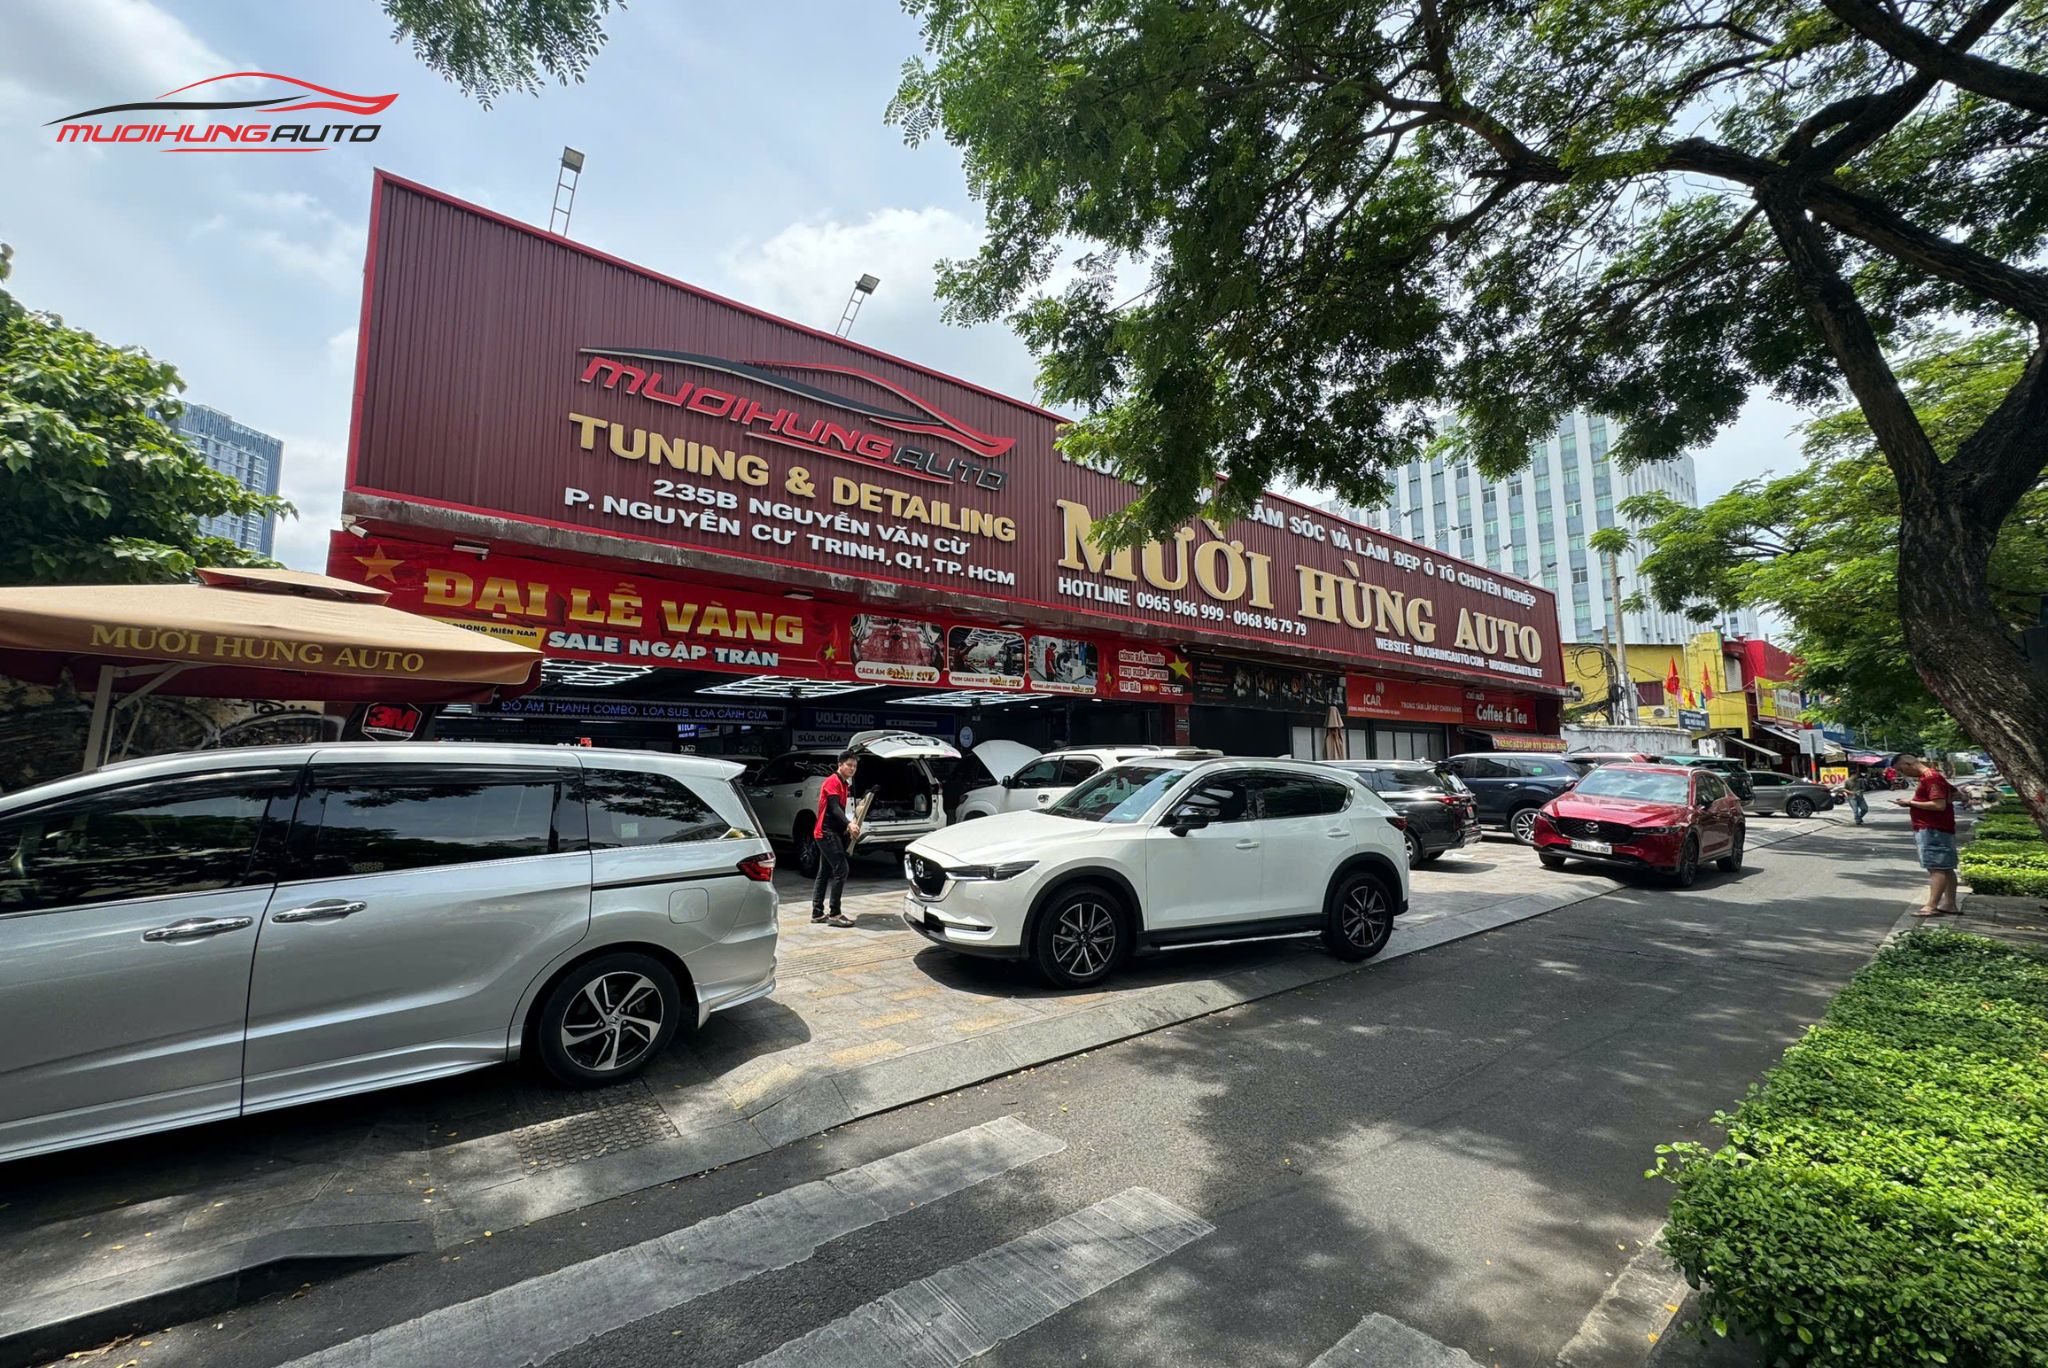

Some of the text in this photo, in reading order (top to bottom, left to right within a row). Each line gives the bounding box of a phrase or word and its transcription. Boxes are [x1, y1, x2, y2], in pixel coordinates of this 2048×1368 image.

[568, 412, 1016, 542] TUNING & DETAILING
[564, 487, 595, 510] P.
[603, 495, 740, 536] NGUYỄN
[751, 523, 798, 545] CƯ
[653, 479, 971, 556] 235B NGUYỄN VĂN CỪ
[1057, 499, 1542, 663] MƯỜI HÙNG AUTO
[1289, 514, 1325, 542] SÓC
[1330, 527, 1352, 551] VÀ
[1355, 537, 1389, 563] LÀM
[1393, 550, 1420, 573] ĐẸP
[1423, 556, 1434, 576] Ô
[1437, 564, 1455, 583] TÔ
[1457, 571, 1501, 596] CHUYÊN
[1502, 585, 1537, 610] NGHIỆP
[424, 567, 805, 645] ĐẠI LỄ VÀNG
[1136, 591, 1171, 613] 0965
[1173, 599, 1198, 618] 966
[1201, 604, 1224, 622] 999
[1233, 610, 1263, 629] 0968
[1264, 616, 1278, 632] 96
[1294, 621, 1308, 637] 79
[334, 647, 425, 672] AUTO
[548, 631, 779, 667] SALE NGẬP TRÀN
[367, 706, 417, 731] 3M
[547, 702, 590, 713] THANH
[643, 706, 665, 717] LOA
[695, 710, 715, 718] LOA
[1363, 694, 1381, 707] ICAR
[1477, 704, 1503, 721] Coffee
